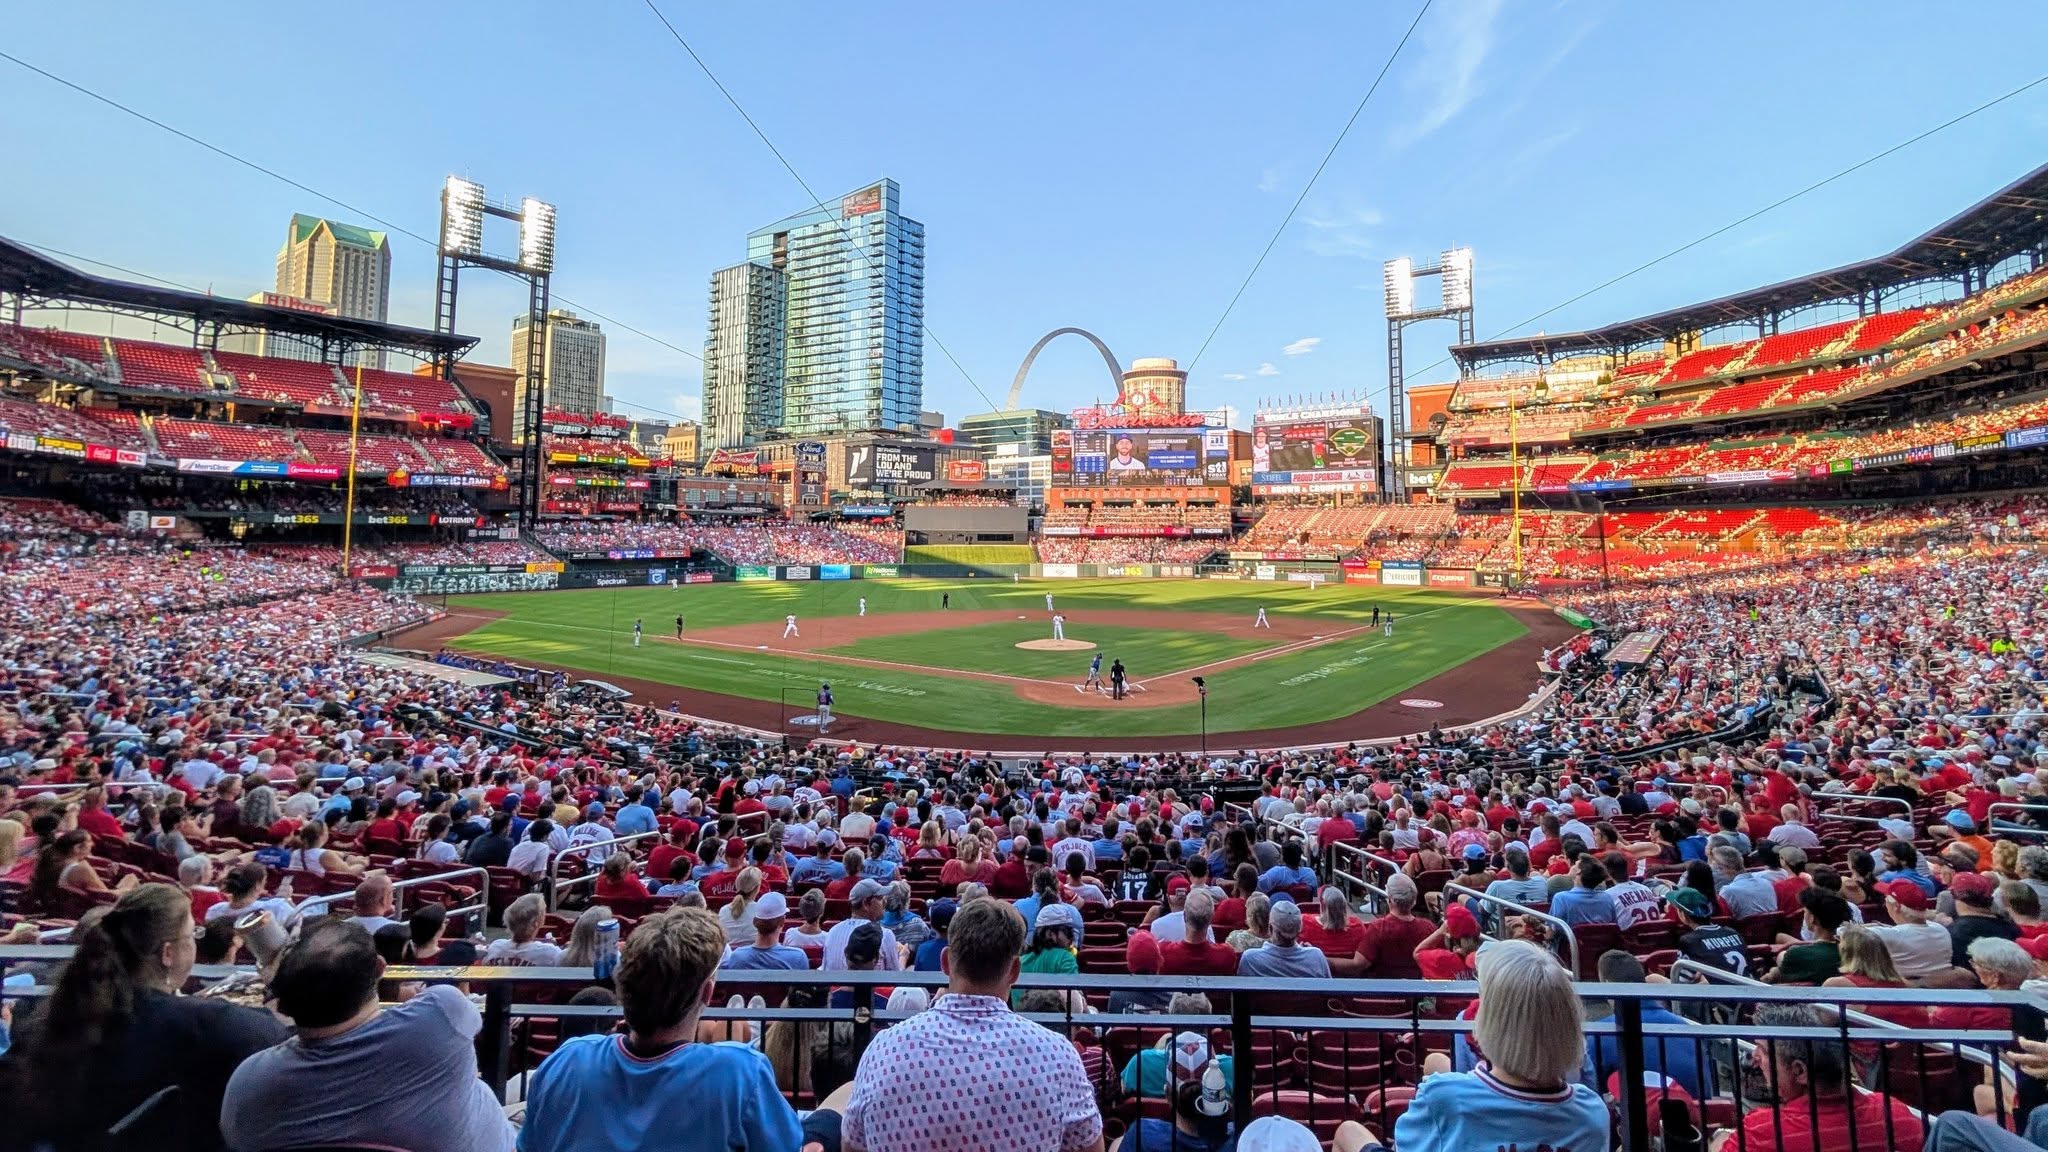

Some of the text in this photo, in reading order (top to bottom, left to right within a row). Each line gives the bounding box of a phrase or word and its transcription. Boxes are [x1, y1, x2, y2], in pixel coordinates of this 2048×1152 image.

[803, 442, 822, 453] Ford
[876, 453, 918, 463] FROM THE
[731, 463, 758, 473] HOUSE
[876, 461, 912, 470] LOU AND
[876, 469, 931, 480] WE'RE PROUD
[1261, 473, 1284, 482] STIFEL
[1314, 472, 1342, 481] SPONSOR
[1671, 475, 1706, 484] UNIVERSITY
[274, 514, 319, 524] bet365
[368, 515, 408, 524] bet365
[438, 516, 476, 524] LOTRIMIN
[1108, 566, 1142, 576] bet365
[597, 578, 627, 586] Spectrum
[1061, 842, 1087, 853] PUJOLS
[1122, 881, 1147, 900] 17
[1618, 889, 1655, 908] ARENAD
[1701, 934, 1743, 950] MURPHY
